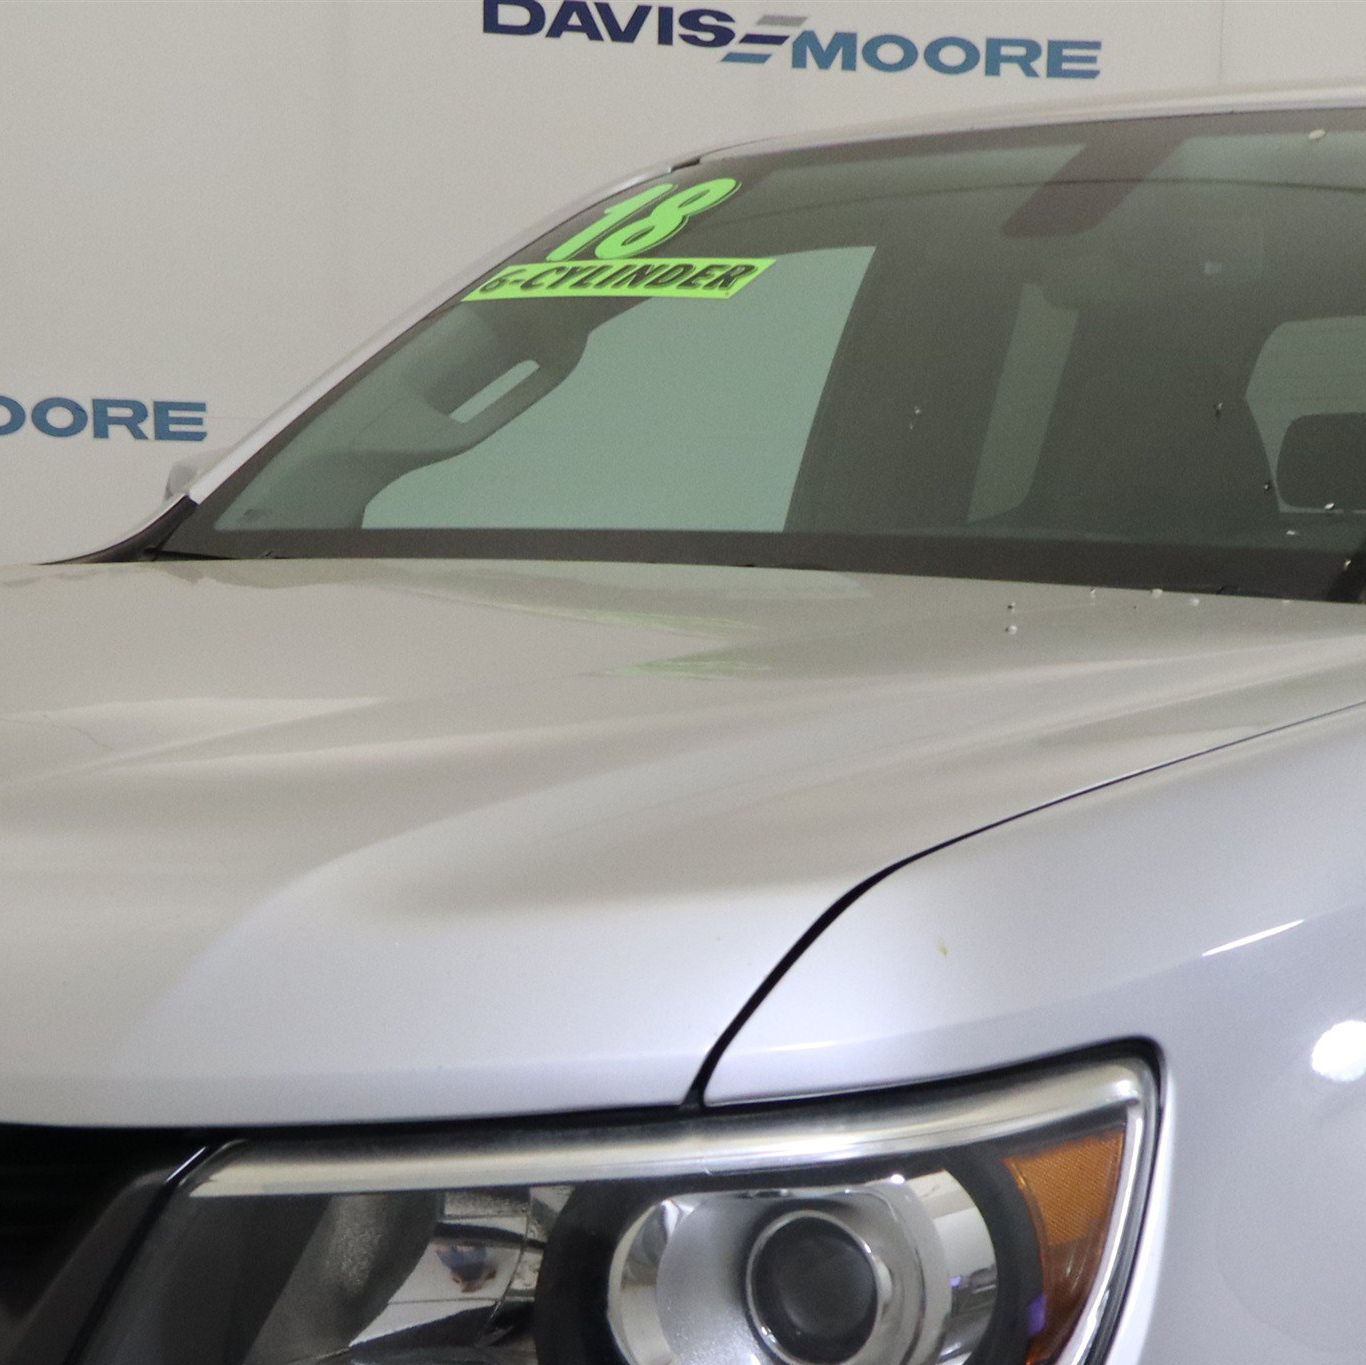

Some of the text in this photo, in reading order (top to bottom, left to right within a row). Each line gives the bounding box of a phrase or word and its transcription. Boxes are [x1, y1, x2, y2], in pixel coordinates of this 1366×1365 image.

[481, 0, 1103, 80] DAVIS MOORE
[545, 177, 742, 262] 18
[478, 263, 759, 294] 6-CYLINDER
